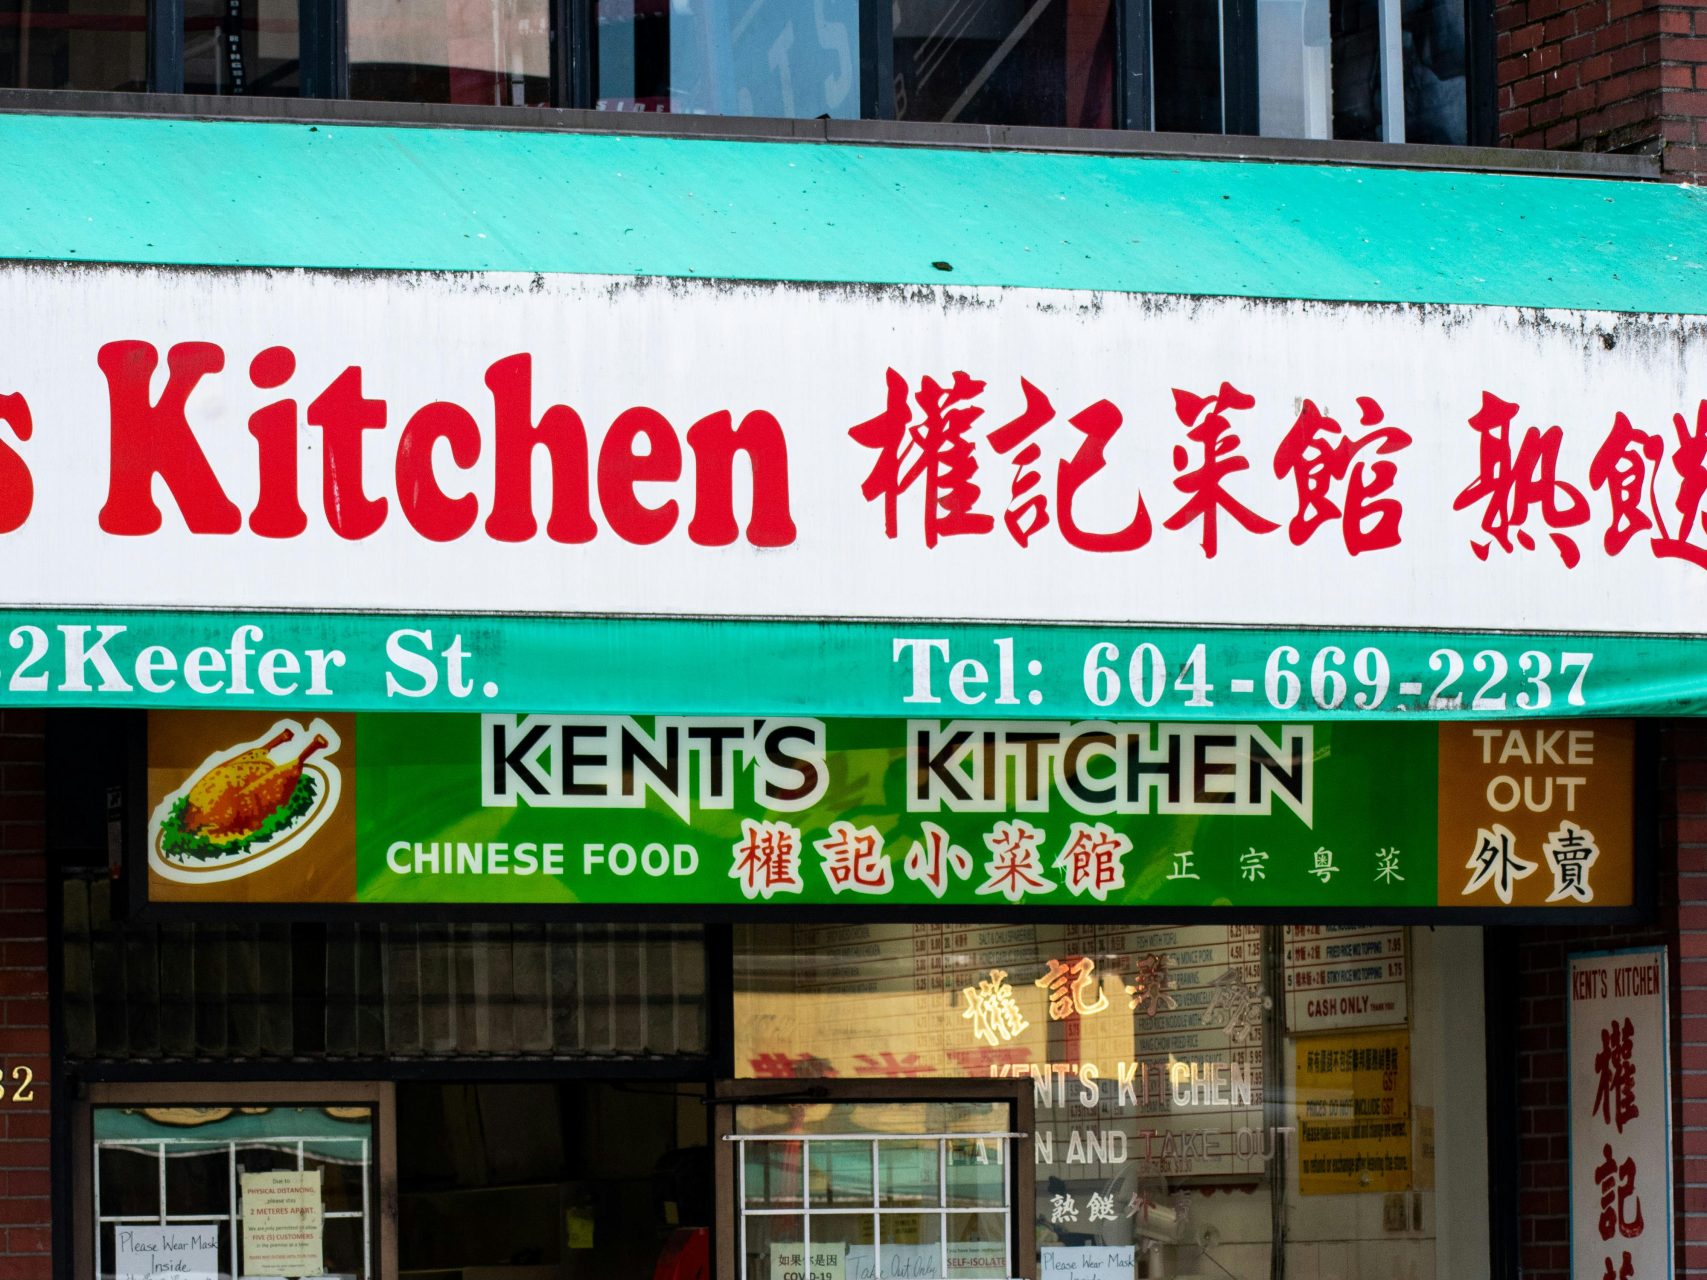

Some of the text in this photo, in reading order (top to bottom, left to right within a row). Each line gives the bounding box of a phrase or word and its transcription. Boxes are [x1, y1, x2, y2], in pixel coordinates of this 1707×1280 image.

[97, 339, 798, 548] Kitchen
[848, 366, 1412, 558] 權記菜館
[386, 627, 499, 699] St.
[892, 637, 1596, 715] Tel: 604-669-2237
[487, 716, 1309, 815] KENT'S KITCHEN
[1473, 728, 1595, 766] TAKE
[1486, 775, 1586, 814] OUT
[386, 841, 700, 878] CHINESE FOOD
[729, 820, 1133, 904] 權記小菜館
[1461, 819, 1601, 904] 外賣
[1287, 950, 1291, 960] 4
[1287, 976, 1292, 986] 5
[1573, 965, 1660, 1001] KENT'S KITCHEN
[1307, 998, 1337, 1018] CASH
[1340, 995, 1369, 1014] ONLY
[1117, 1061, 1252, 1107] KITCHEN
[1383, 1071, 1398, 1091] GST
[1354, 1098, 1381, 1115] INCLUDE
[1382, 1097, 1394, 1115] GST
[1066, 1125, 1297, 1165] AND TAKE OUT
[120, 1231, 218, 1252] Please Wear Mask
[152, 1254, 191, 1274] Inside
[891, 1254, 909, 1277] Out
[913, 1255, 937, 1279] Only
[1043, 1251, 1134, 1270] Please Wear Mask
